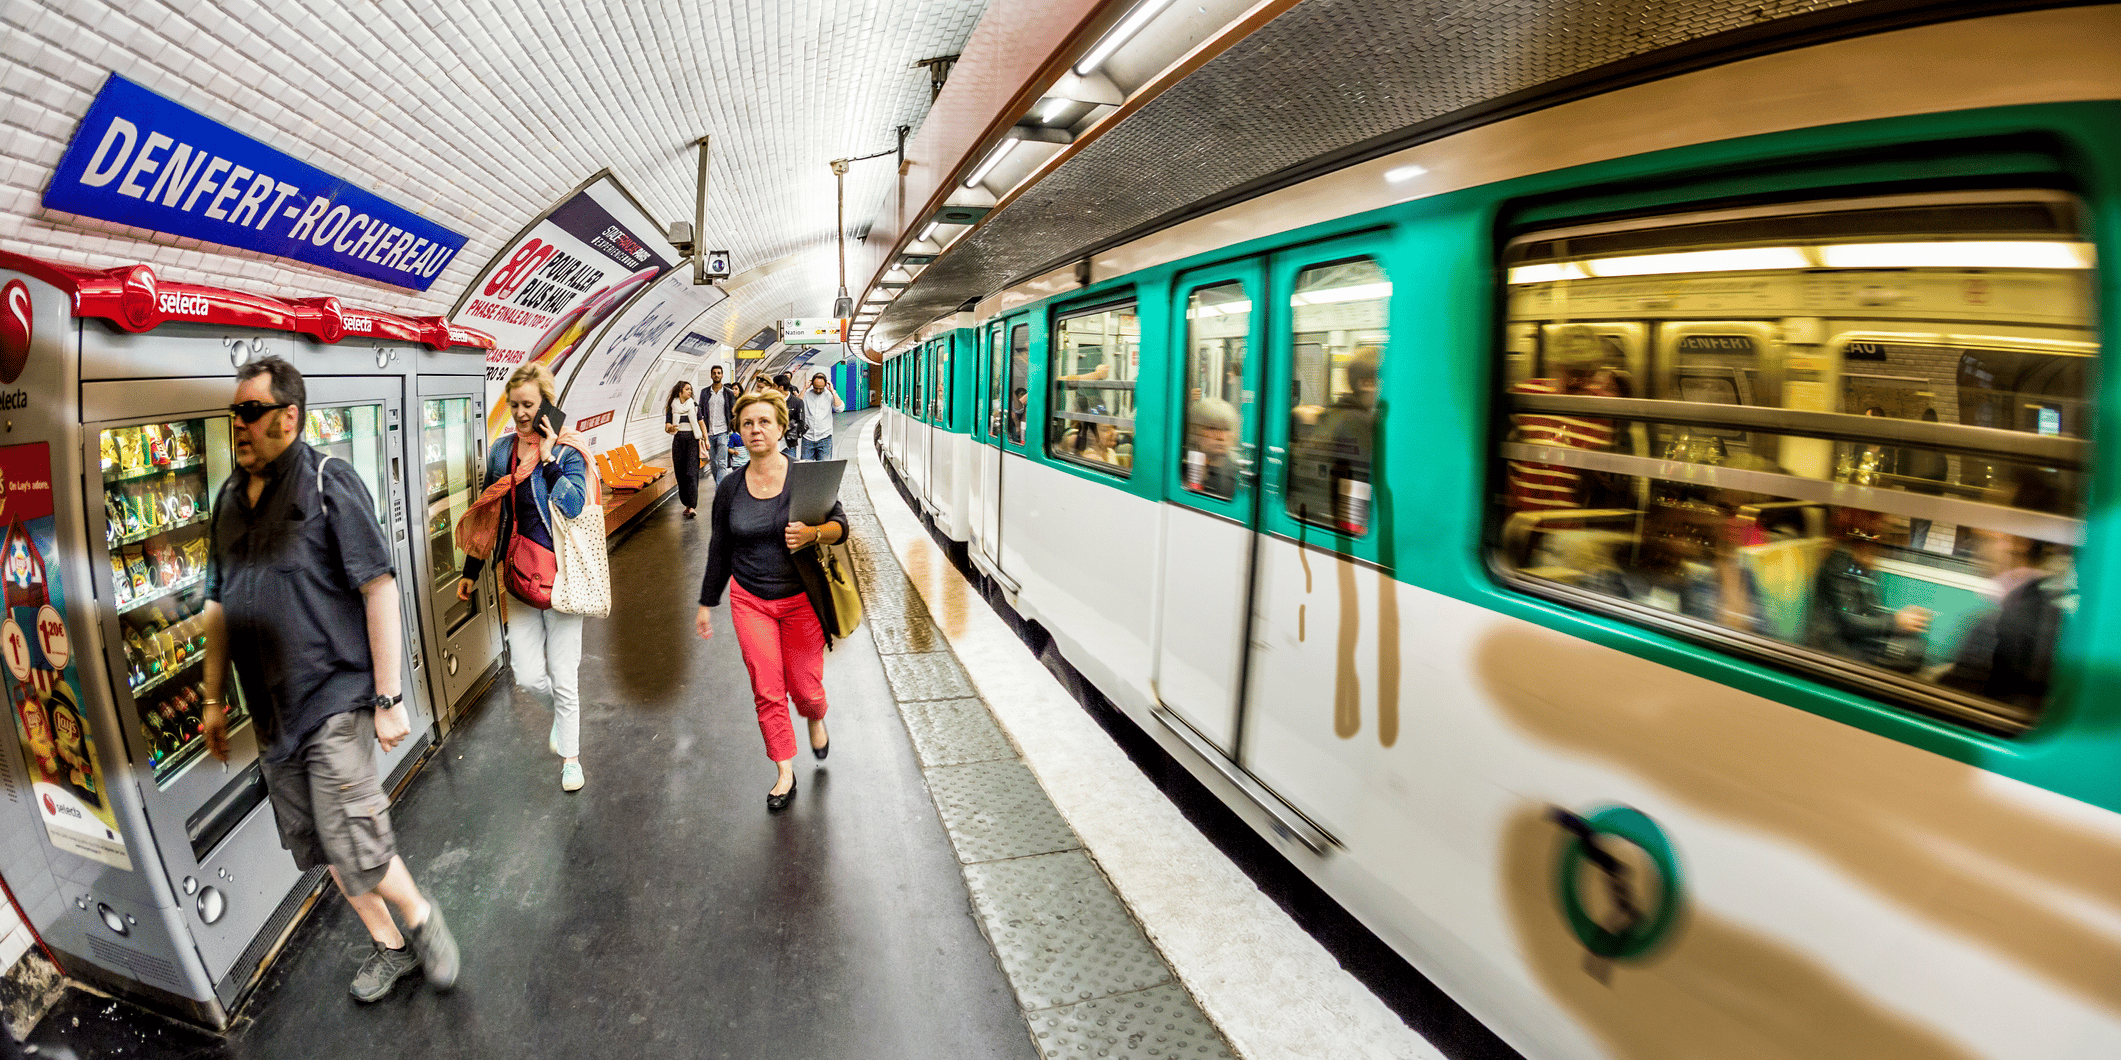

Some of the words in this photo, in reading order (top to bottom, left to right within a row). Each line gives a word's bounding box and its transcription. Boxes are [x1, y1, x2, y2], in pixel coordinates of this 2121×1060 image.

[80, 116, 454, 279] DENFERT-ROCHEREAU
[538, 251, 582, 284] POUR
[564, 264, 604, 293] ALLER
[158, 291, 208, 316] selecta
[513, 278, 555, 309] PLUS
[539, 287, 577, 315] HAUT
[465, 299, 501, 320] PHASE
[493, 306, 525, 325] FINALE
[518, 311, 535, 327] DU
[528, 314, 546, 328] TOP
[342, 315, 372, 333] selecta
[449, 329, 468, 342] selecta
[501, 350, 526, 364] PARIS
[496, 366, 509, 381] 92
[0, 388, 28, 410] lecta
[8, 481, 17, 491] On
[56, 803, 82, 819] selecta
